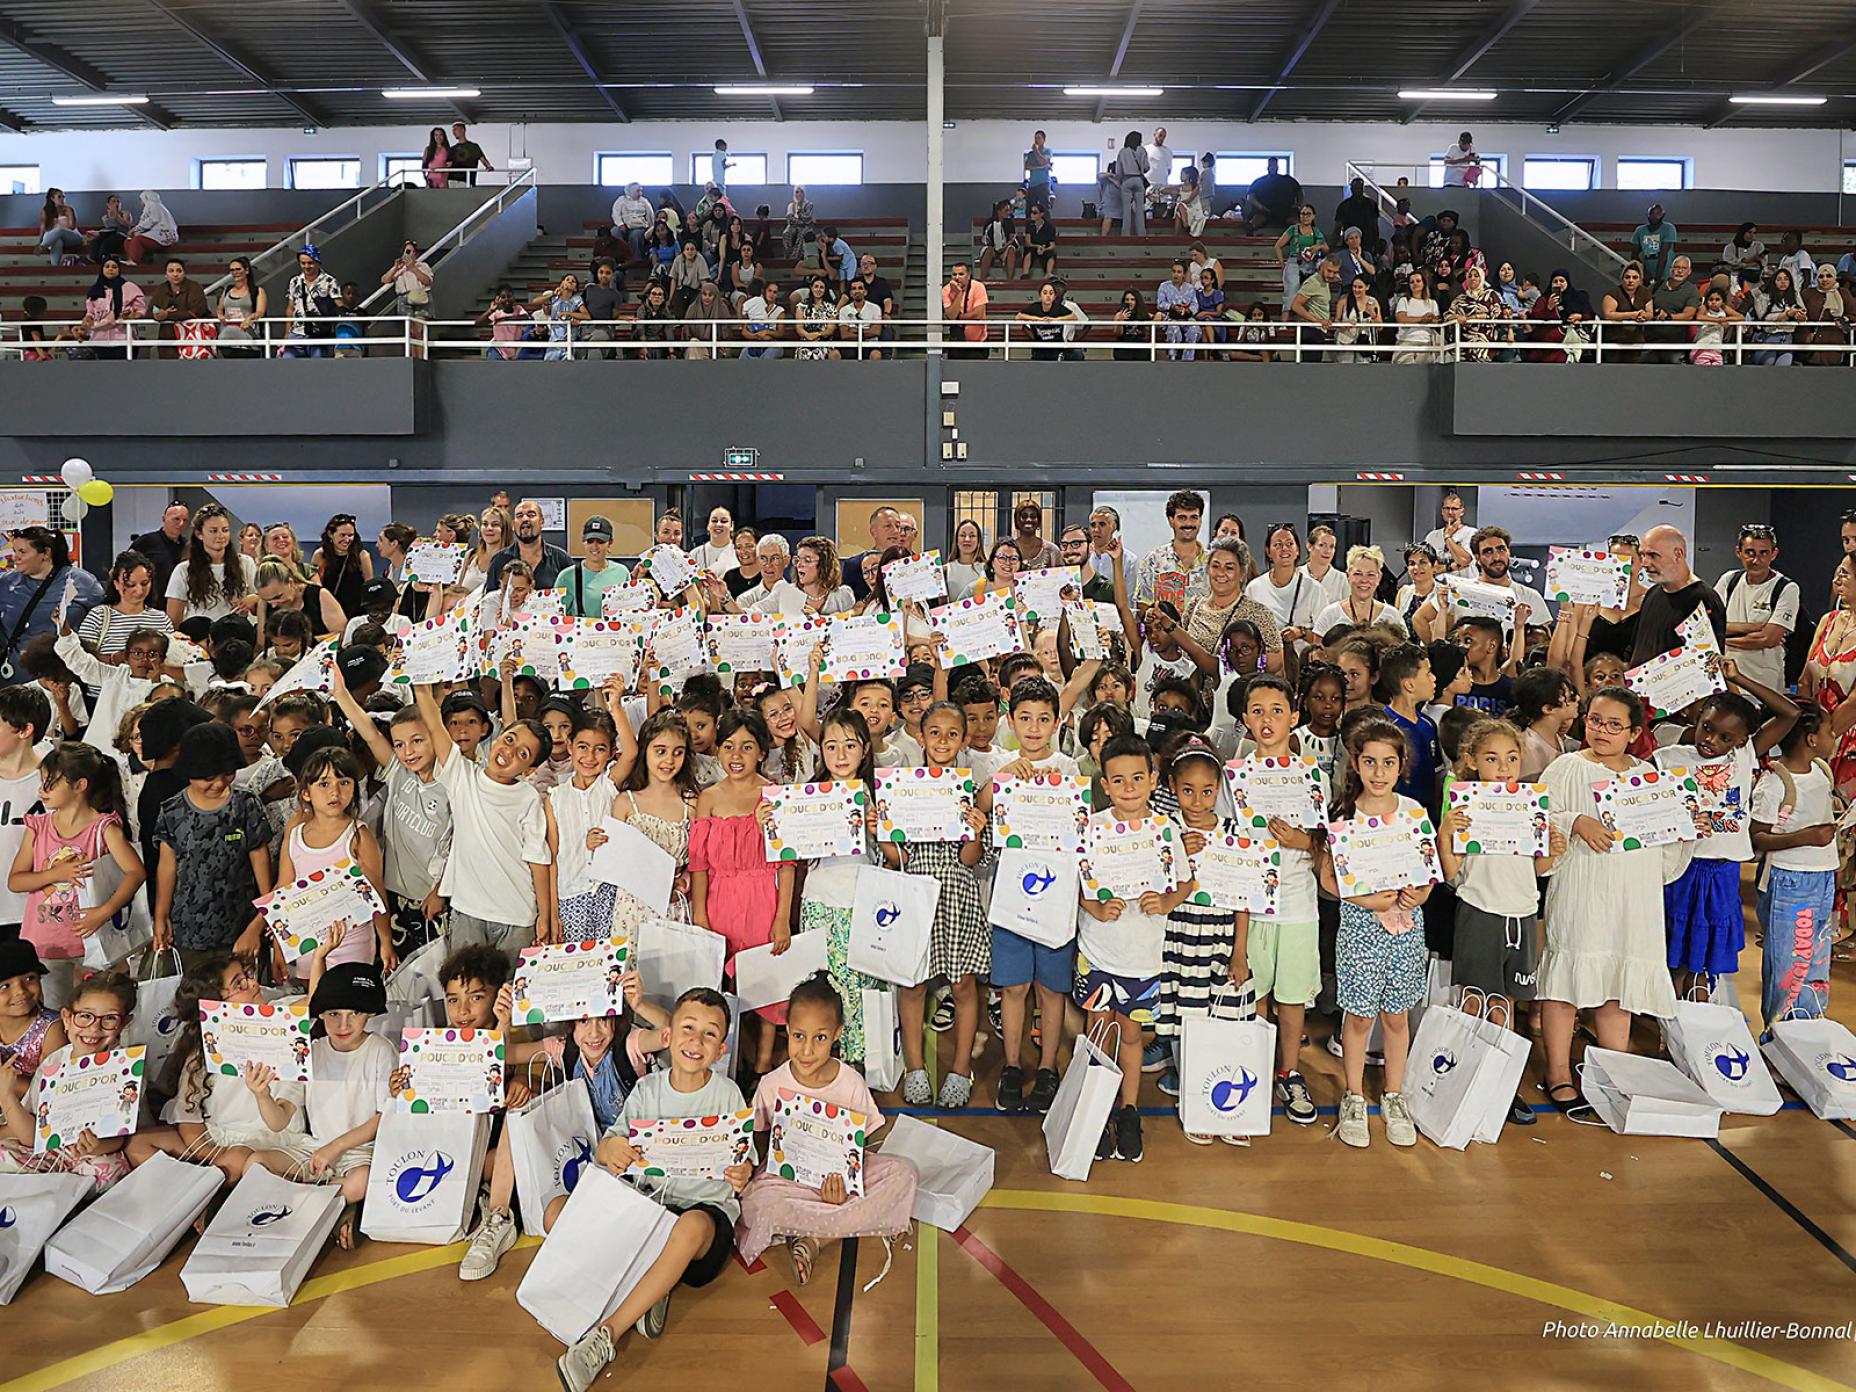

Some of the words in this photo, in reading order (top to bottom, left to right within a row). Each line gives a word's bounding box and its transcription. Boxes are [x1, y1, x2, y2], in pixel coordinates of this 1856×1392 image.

[1282, 776, 1304, 785] D'OR
[931, 787, 953, 796] D'OR
[1615, 795, 1650, 807] POUCE
[1651, 789, 1677, 801] D'OR
[1013, 794, 1046, 804] POUCE
[1048, 795, 1072, 806] D'OR
[1472, 801, 1504, 811] POUCE
[1506, 802, 1528, 812] D'OR
[393, 793, 437, 838] SORTCLUB
[783, 804, 816, 814] POUCE
[819, 802, 843, 812] D'OR
[1096, 844, 1130, 855] POUCE
[1132, 839, 1155, 850] D'OR
[1237, 857, 1260, 868] D'OR
[285, 892, 320, 912] POUCE
[320, 880, 345, 896] D'OR
[1794, 908, 1813, 960] TODAY
[537, 961, 575, 973] POUCE
[576, 958, 604, 969] D'OR
[1515, 971, 1537, 985] NAS
[221, 1023, 259, 1035] POUCE
[260, 1024, 287, 1036] D'OR
[420, 1052, 457, 1063] POUCE
[458, 1052, 484, 1063] D'OR
[1704, 1041, 1724, 1065] TOULON
[55, 1080, 88, 1096] POUCE
[89, 1073, 118, 1088] D'OR
[1202, 1064, 1232, 1096] TOULON
[655, 1135, 698, 1145] POUCE
[699, 1133, 729, 1144] D'OR
[790, 1119, 821, 1137] POUCE
[821, 1129, 845, 1145] D'OR
[386, 1150, 426, 1185] TOULON
[554, 1142, 571, 1189] TOULON
